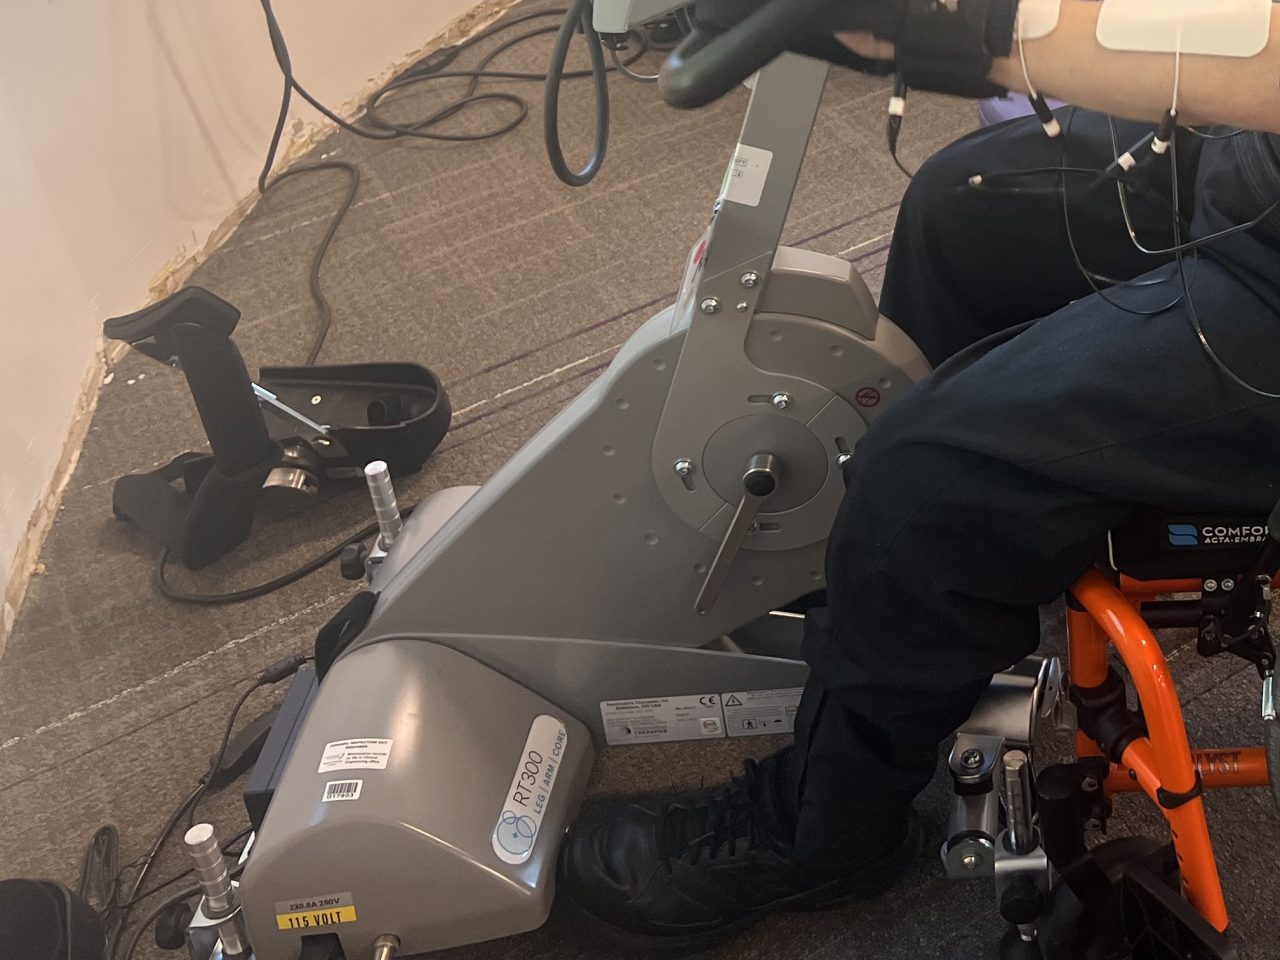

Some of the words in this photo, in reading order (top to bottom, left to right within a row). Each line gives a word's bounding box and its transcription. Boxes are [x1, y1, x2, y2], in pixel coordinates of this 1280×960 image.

[512, 750, 543, 807] RT300
[534, 793, 546, 814] LEG
[544, 764, 556, 787] ARM
[552, 729, 566, 757] CORE
[1194, 750, 1241, 777] LYST
[288, 915, 309, 929] 115
[313, 911, 342, 926] VOLT
